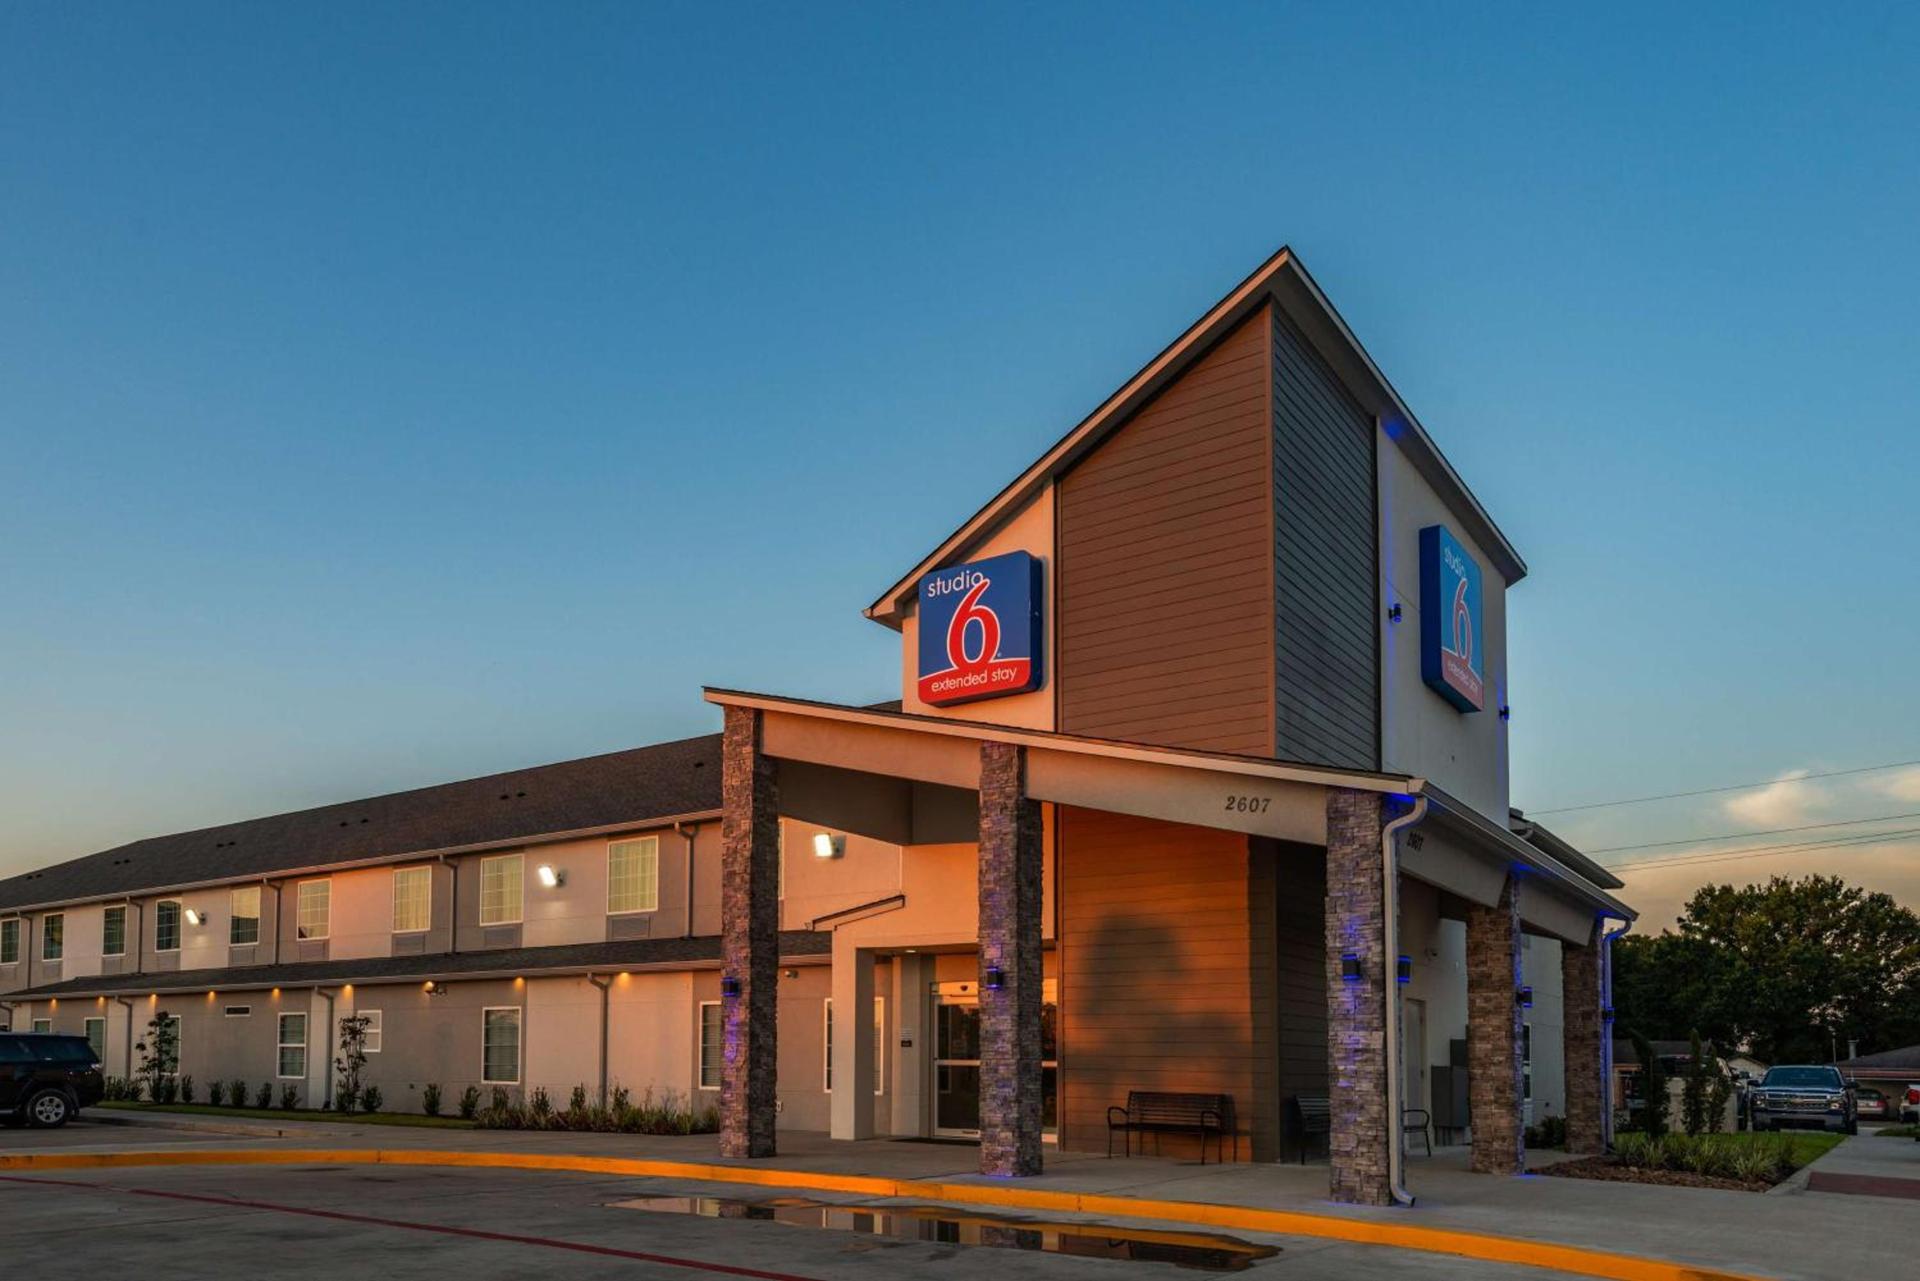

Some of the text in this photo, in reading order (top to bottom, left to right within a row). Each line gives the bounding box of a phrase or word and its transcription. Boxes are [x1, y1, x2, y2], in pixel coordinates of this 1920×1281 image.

[928, 570, 984, 597] studio
[947, 578, 1000, 668] 6
[1453, 578, 1472, 666] 6
[931, 667, 1018, 692] extended stay
[1225, 796, 1272, 813] 2607
